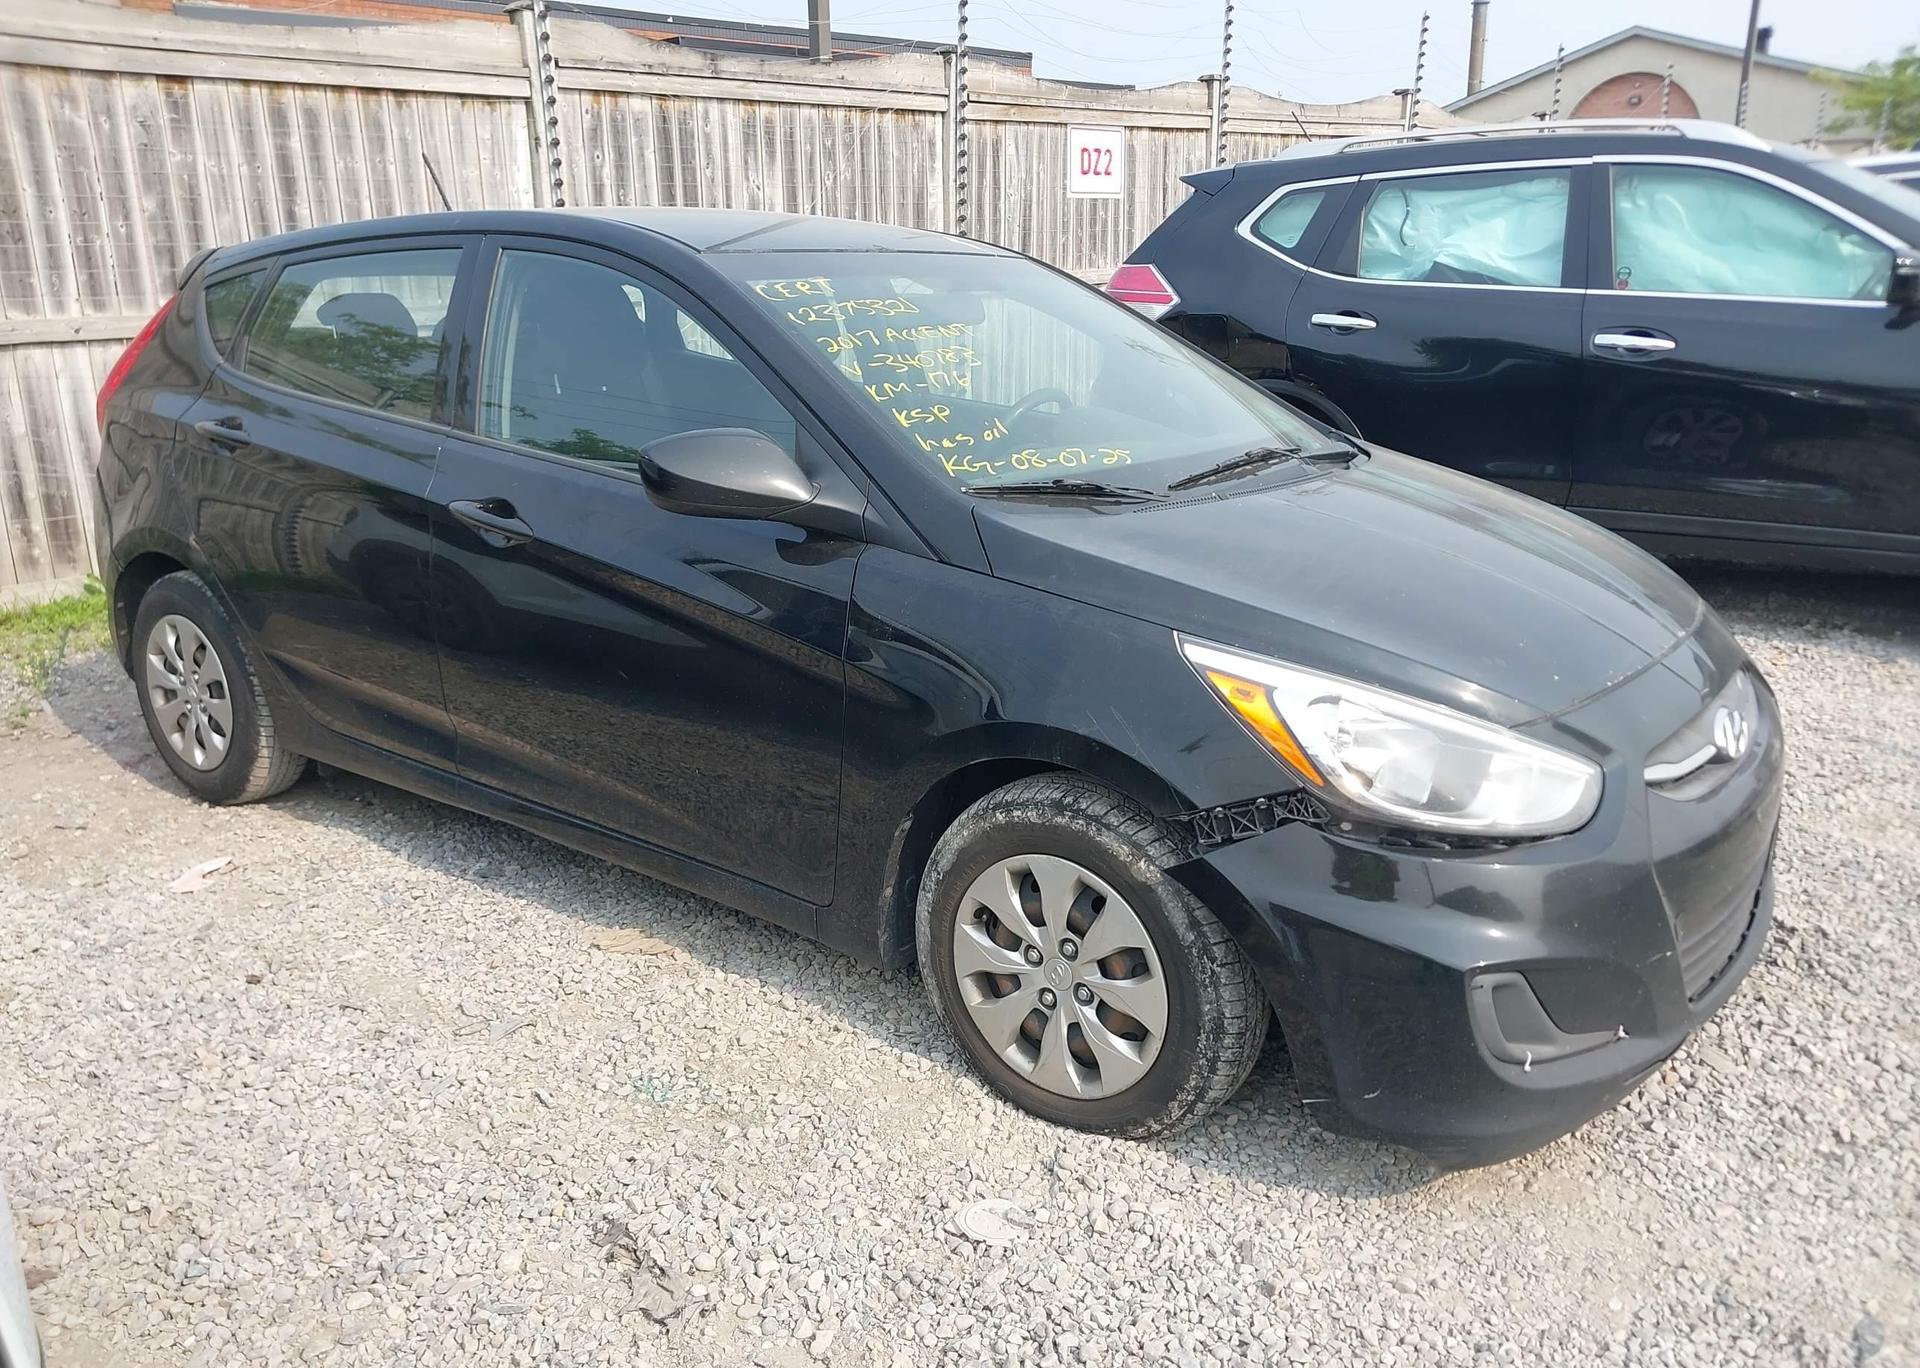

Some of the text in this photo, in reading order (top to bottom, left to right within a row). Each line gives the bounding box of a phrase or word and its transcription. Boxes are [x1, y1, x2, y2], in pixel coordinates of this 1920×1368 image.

[1080, 147, 1113, 176] DZ2
[756, 278, 836, 301] CERT
[817, 323, 974, 353] 2017 ACCENT
[915, 418, 1009, 451] has oil
